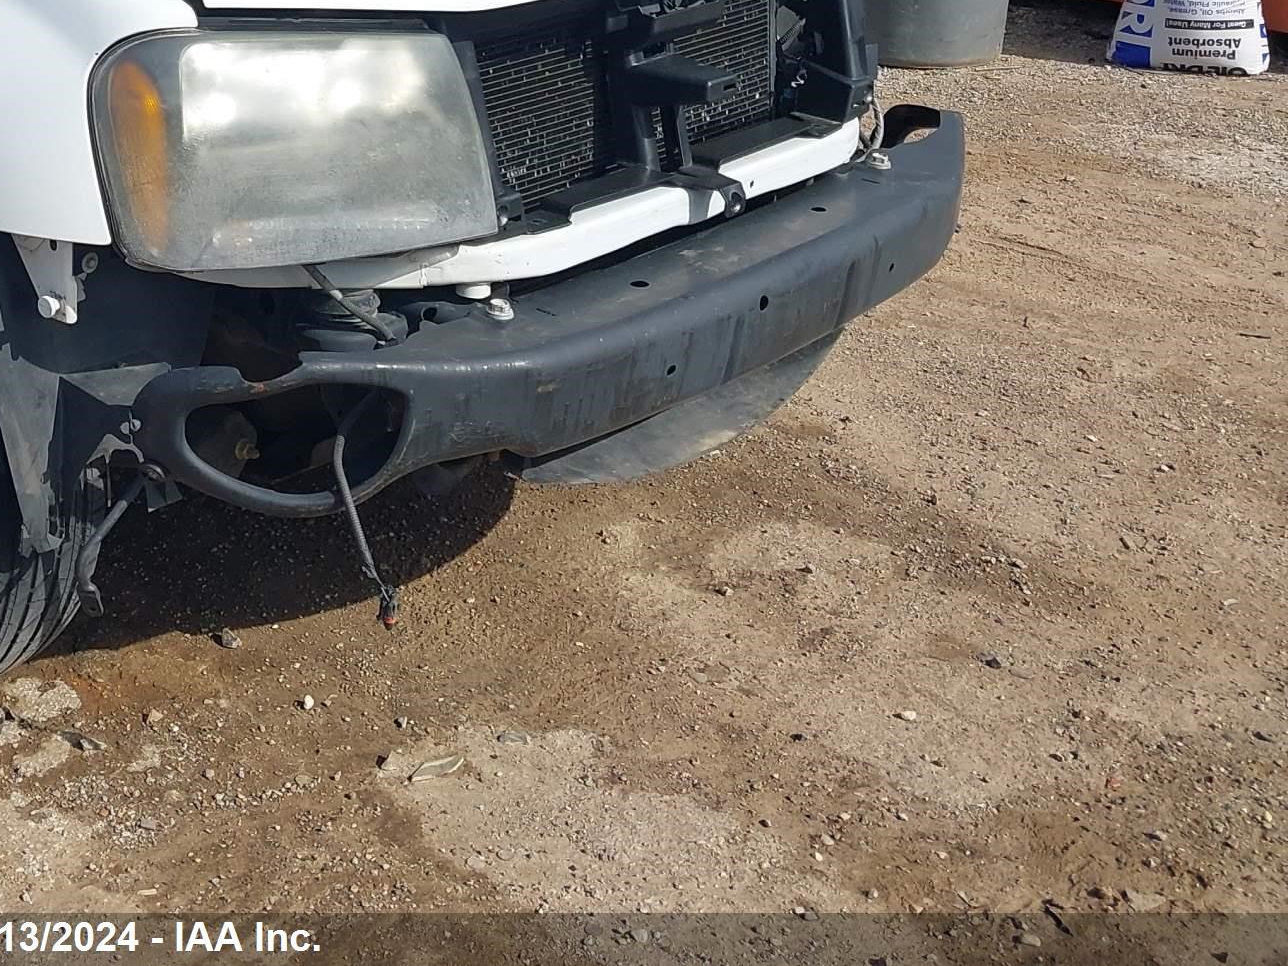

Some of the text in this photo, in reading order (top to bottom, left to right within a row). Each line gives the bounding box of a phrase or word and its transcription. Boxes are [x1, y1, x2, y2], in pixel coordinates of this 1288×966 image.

[1190, 20, 1211, 29] Many
[1213, 21, 1226, 29] For
[1168, 36, 1242, 49] Absorbent
[1172, 48, 1236, 60] Premium
